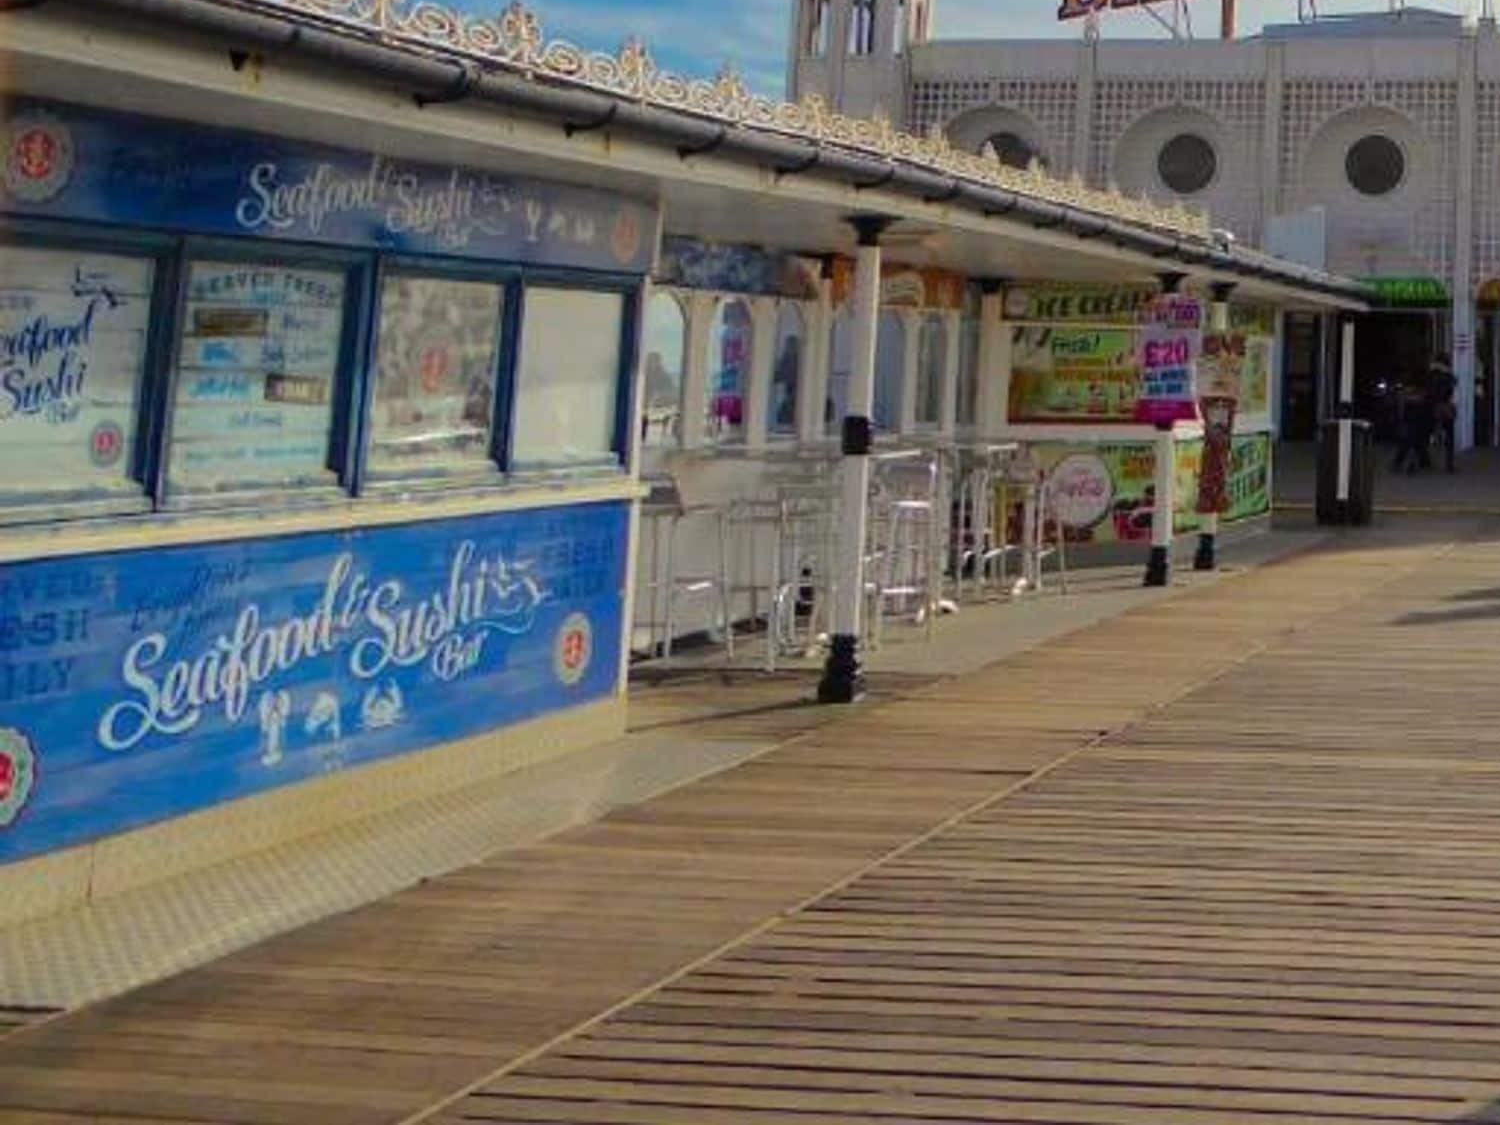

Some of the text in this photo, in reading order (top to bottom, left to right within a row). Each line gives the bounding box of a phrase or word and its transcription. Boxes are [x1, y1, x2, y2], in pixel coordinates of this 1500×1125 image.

[236, 154, 380, 231] Seafood
[384, 169, 474, 235] Sushi
[0, 298, 96, 367] eafood
[1144, 338, 1191, 368] £20
[1, 351, 87, 415] Sushi
[99, 553, 352, 751] Seafood
[350, 539, 488, 679] Sushi
[432, 630, 488, 681] Bar
